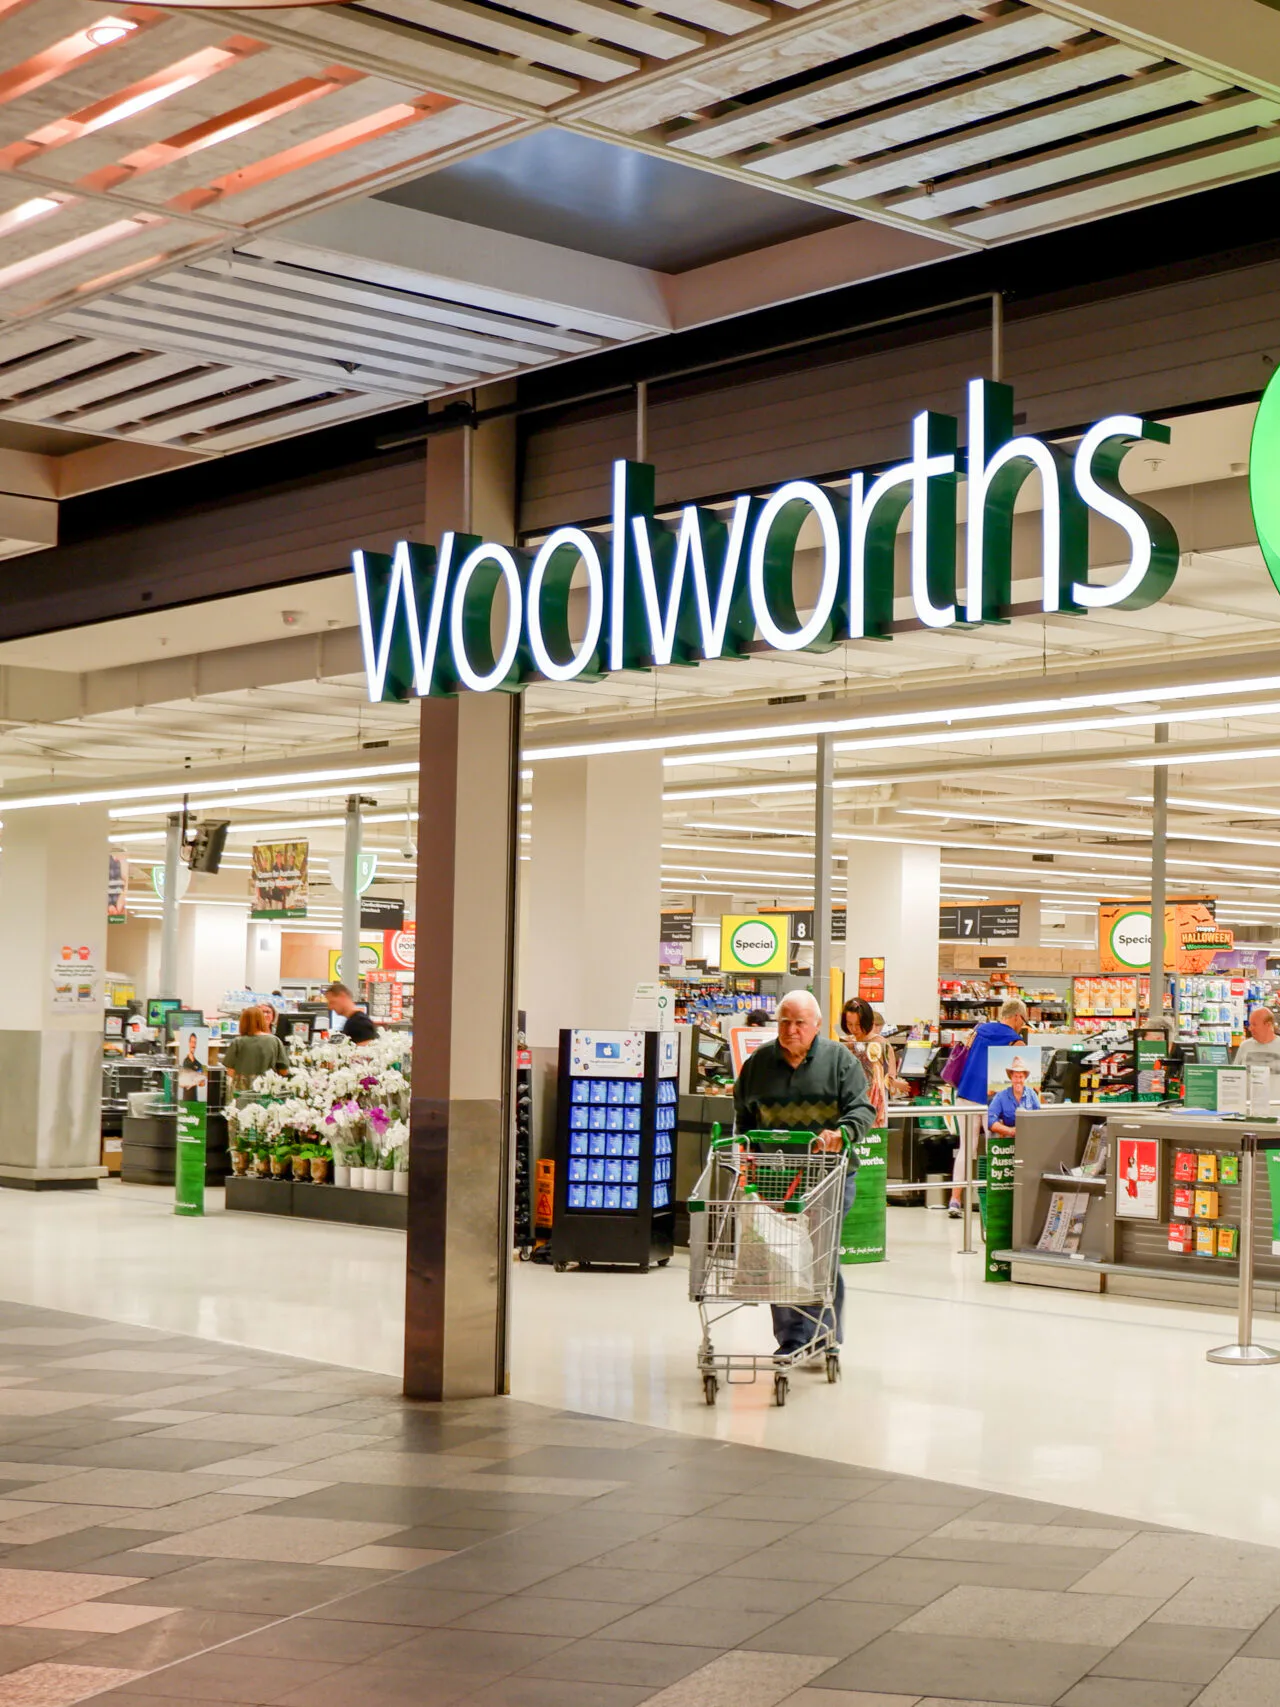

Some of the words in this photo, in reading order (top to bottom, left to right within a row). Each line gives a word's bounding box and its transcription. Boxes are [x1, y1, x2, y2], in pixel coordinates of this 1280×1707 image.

[352, 376, 1158, 703] woolworths
[797, 922, 806, 938] 8
[964, 919, 974, 936] 7
[1181, 932, 1232, 944] HALLOWEEN
[735, 939, 773, 951] Special
[991, 1145, 1015, 1155] Quali
[991, 1168, 1003, 1179] by
